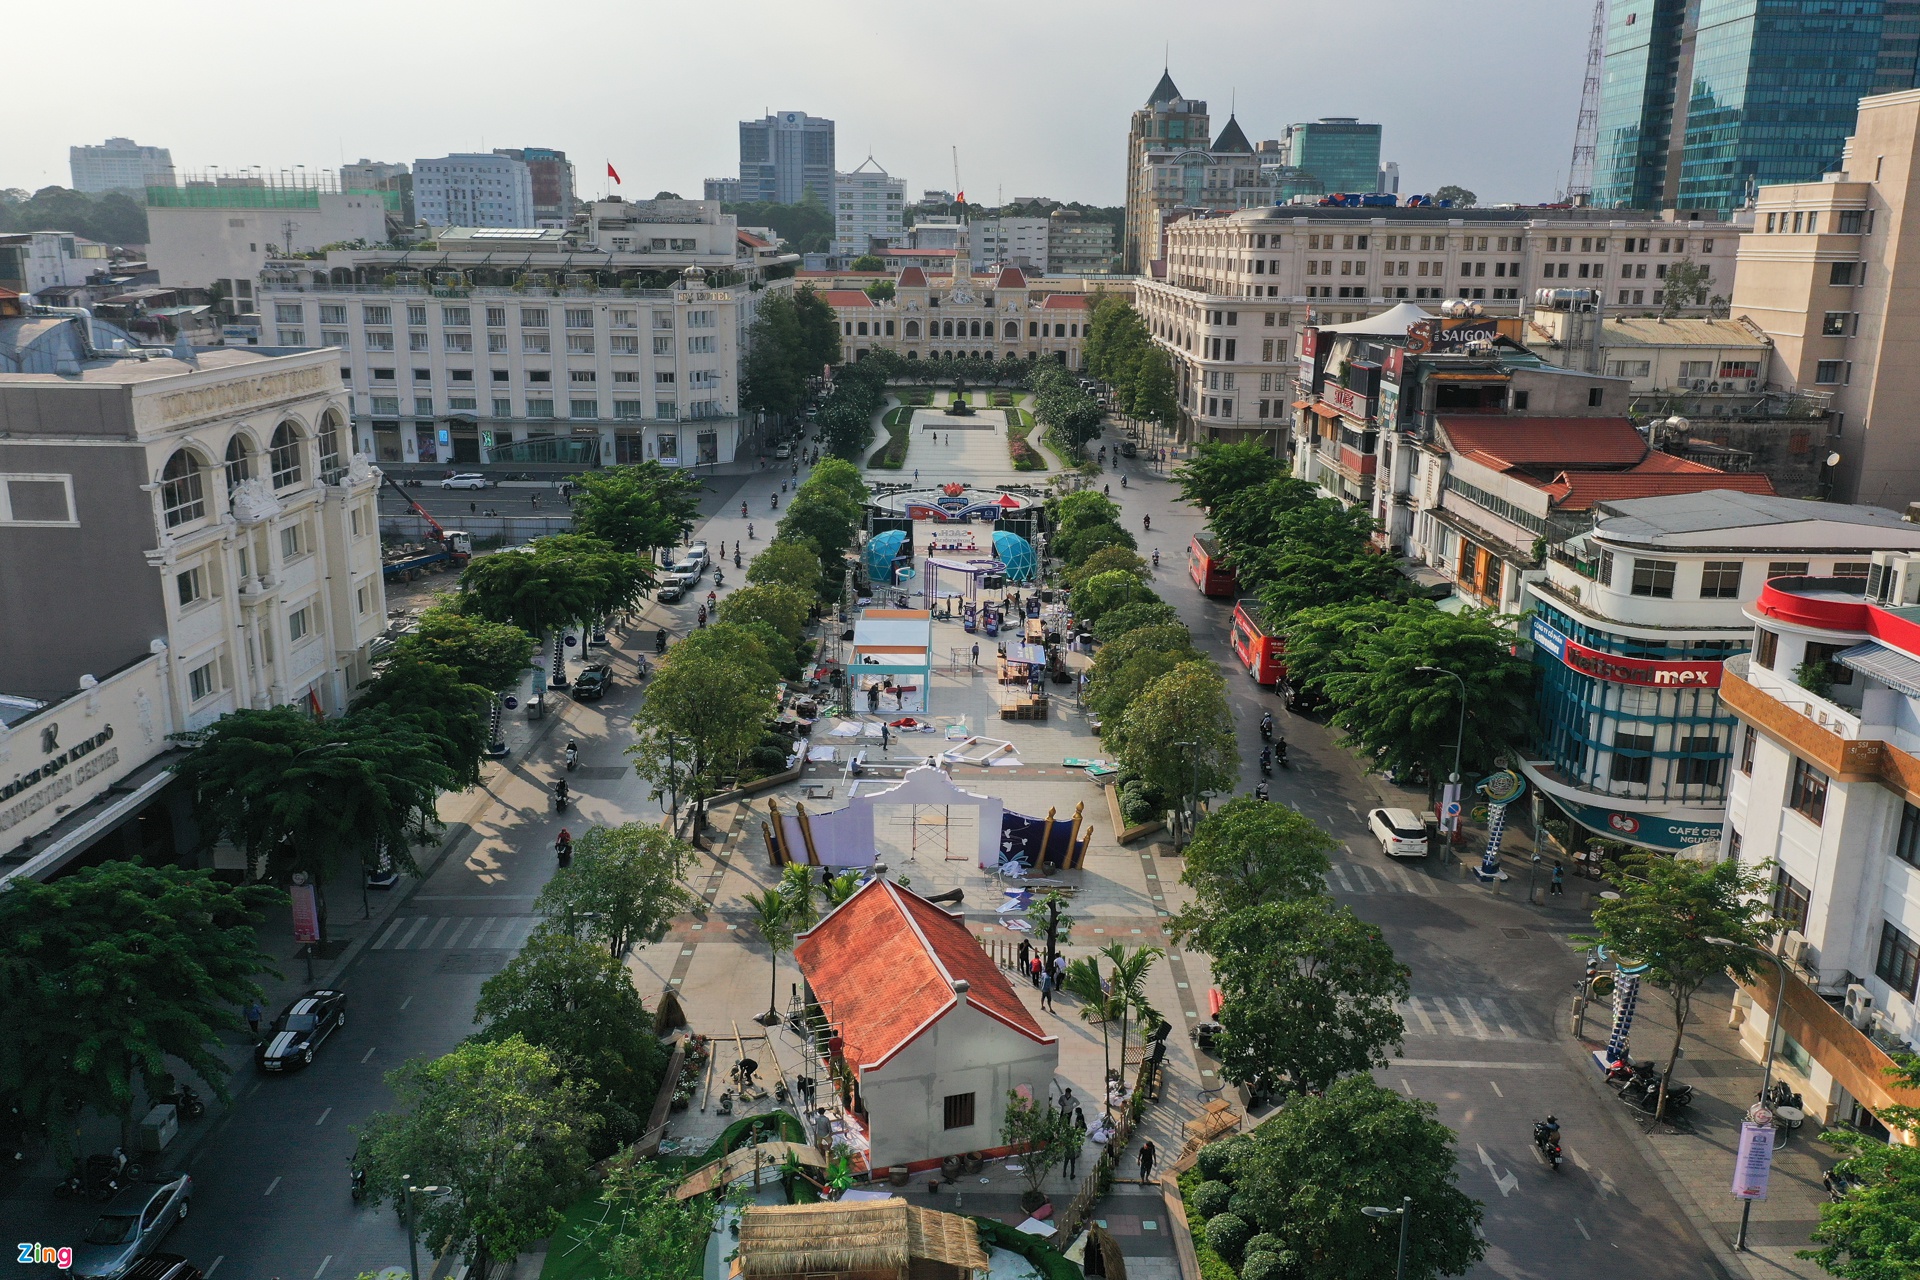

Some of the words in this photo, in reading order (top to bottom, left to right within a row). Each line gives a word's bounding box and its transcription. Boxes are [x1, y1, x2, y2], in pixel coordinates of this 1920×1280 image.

[434, 290, 470, 299] ROLEX
[1441, 329, 1495, 342] SAIGON
[1567, 645, 1709, 685] Viettronimex
[1857, 741, 1869, 749] SSI
[75, 746, 120, 786] CENTER
[1668, 826, 1700, 836] CAFÉ
